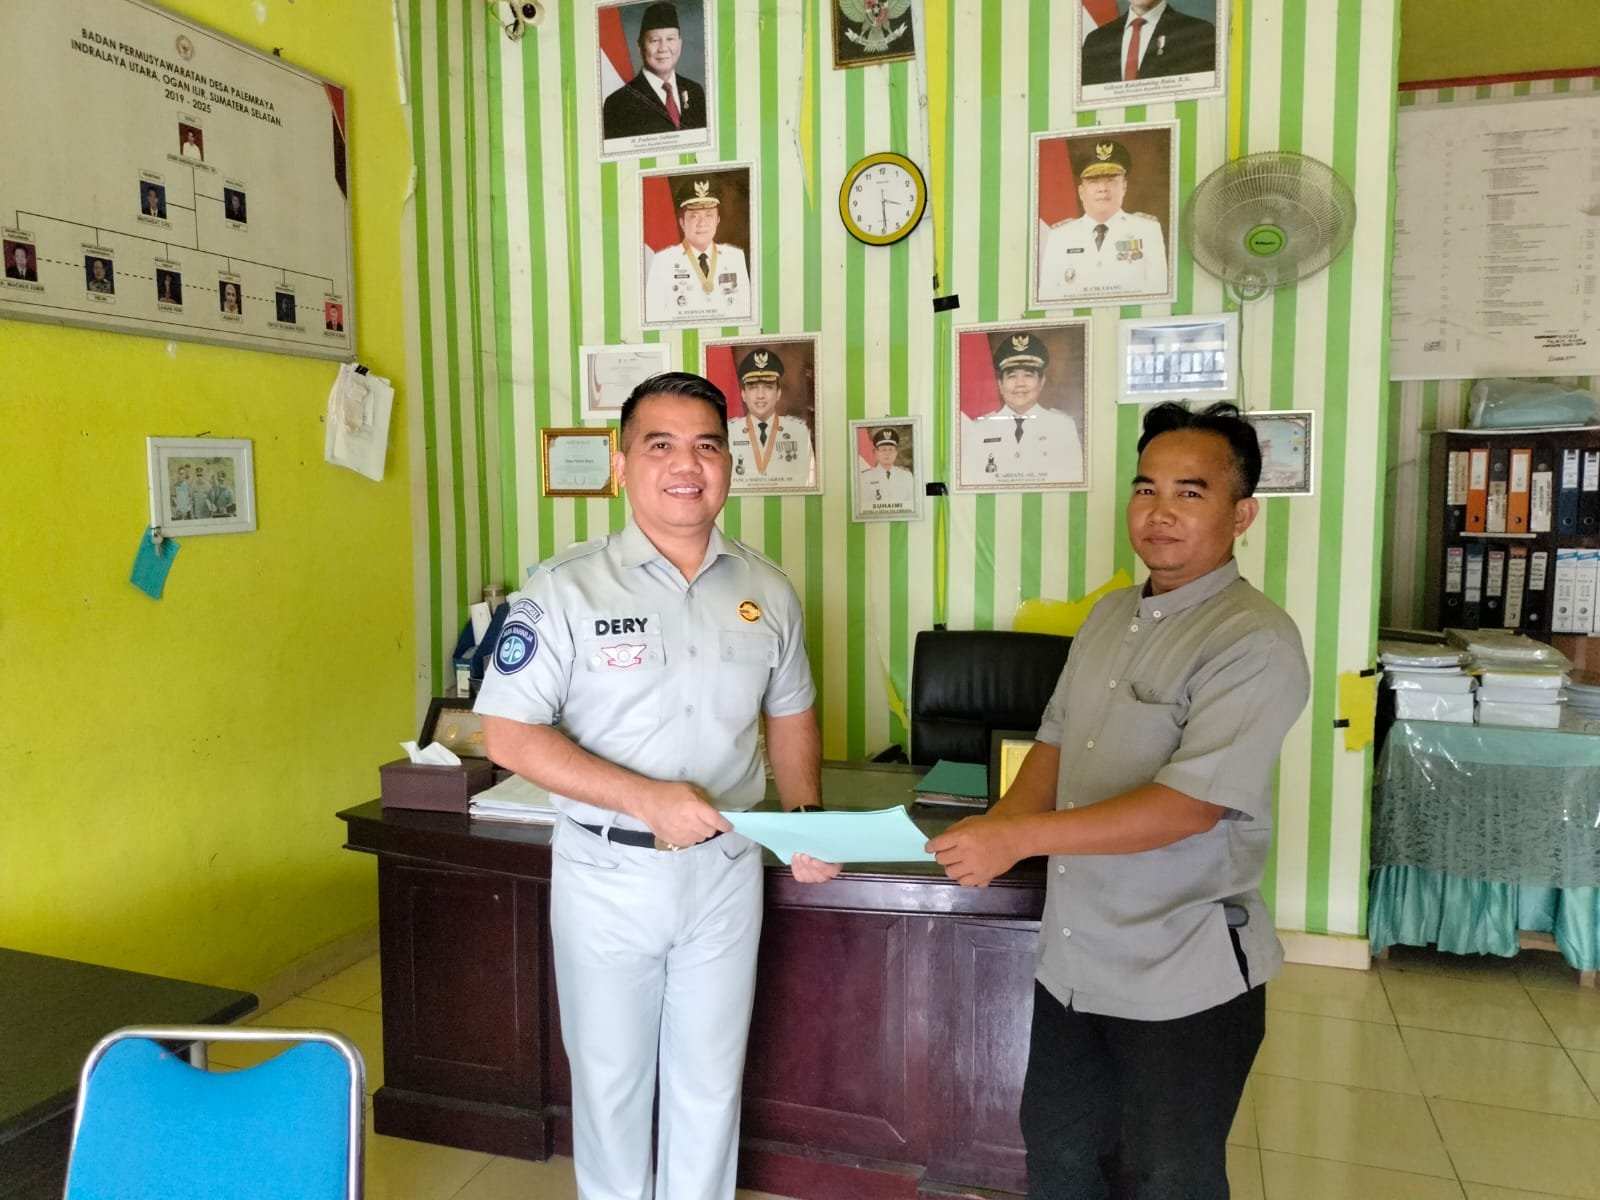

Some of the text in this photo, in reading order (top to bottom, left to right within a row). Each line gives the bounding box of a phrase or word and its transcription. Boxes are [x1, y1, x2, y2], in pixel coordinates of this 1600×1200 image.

[71, 39, 127, 69] INDRALAYA
[163, 75, 190, 92] OGAN
[209, 92, 249, 114] SUMATERA
[82, 28, 275, 112] BADAN PERMUSYAWARATAN DESA PALEMRAYA
[165, 89, 184, 104] 2019
[193, 99, 212, 114] 2025
[595, 618, 648, 635] DERY
